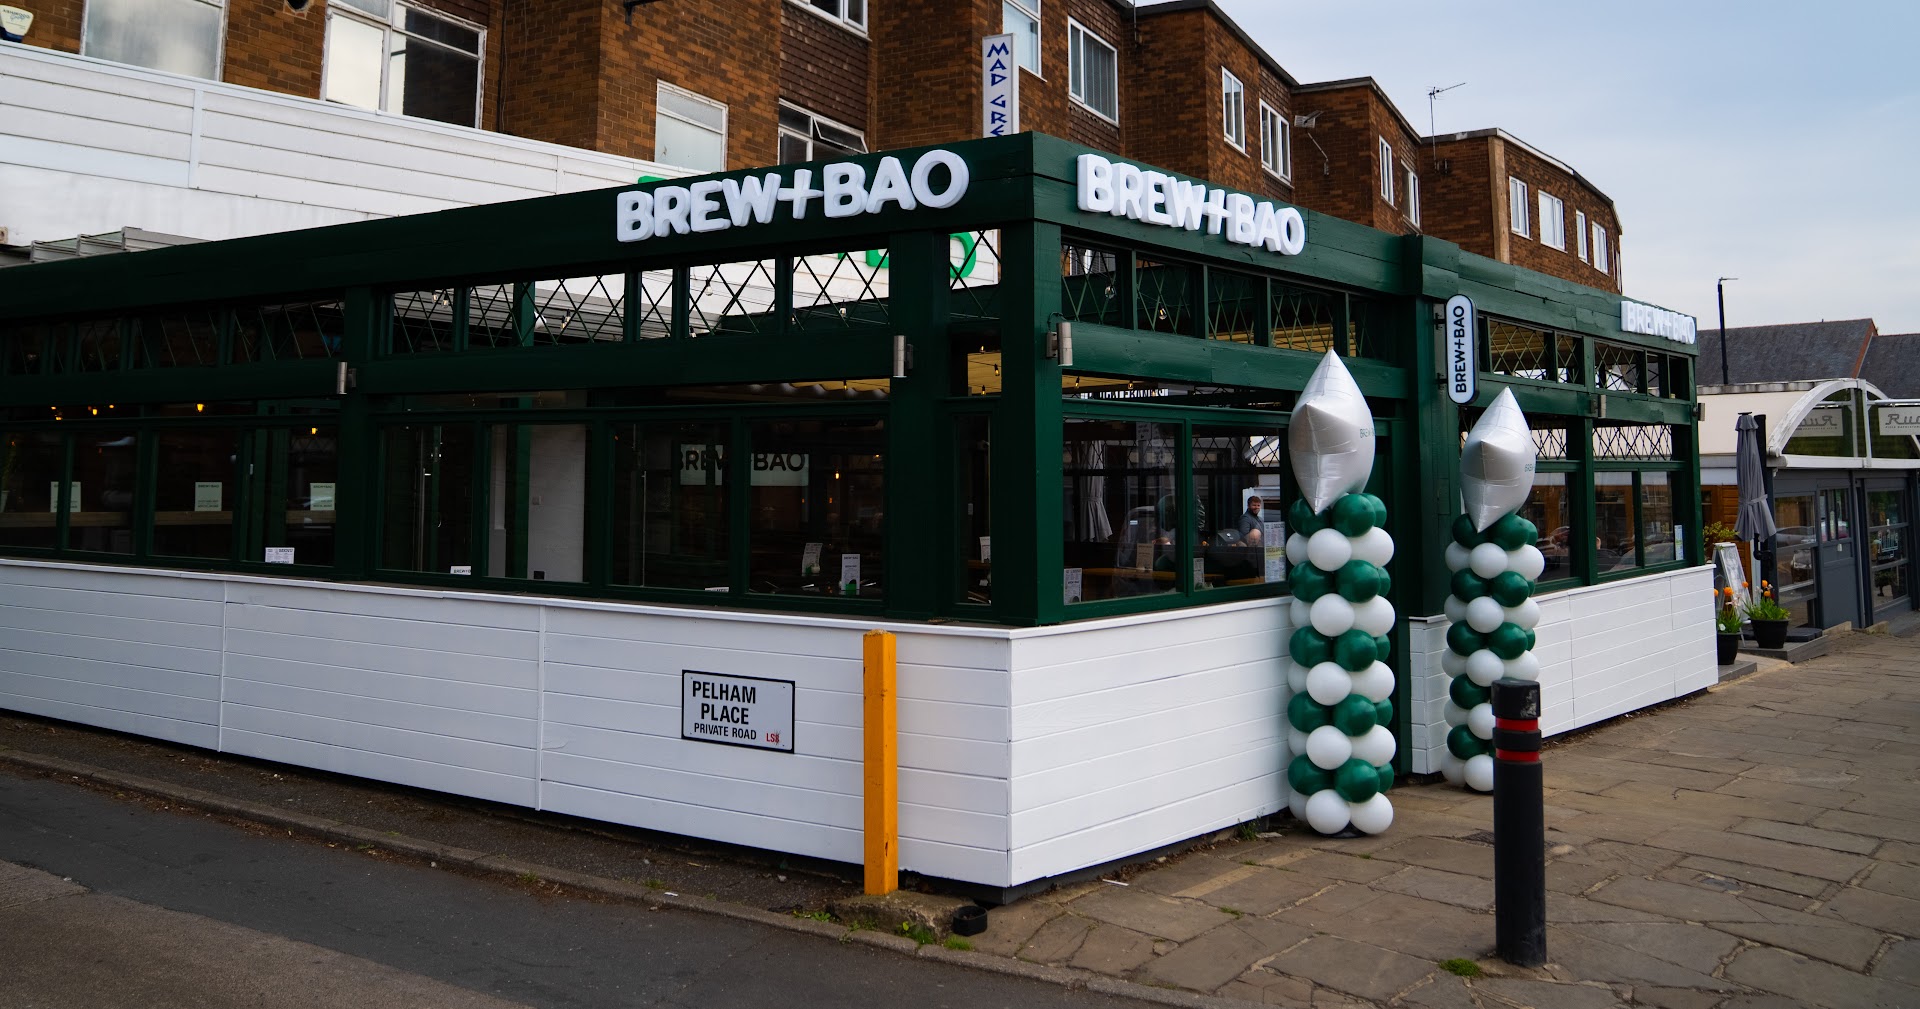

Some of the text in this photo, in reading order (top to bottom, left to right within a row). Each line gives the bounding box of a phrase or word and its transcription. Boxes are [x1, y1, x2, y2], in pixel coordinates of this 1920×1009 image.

[986, 42, 1009, 87] MAD
[616, 149, 970, 242] BREW+BAO
[1077, 153, 1305, 256] BREW+BAO
[1621, 300, 1695, 344] BREW+BAO
[1452, 305, 1467, 393] BREW+BAO
[692, 680, 756, 704] PELHAM
[701, 702, 749, 725] PLACE
[694, 722, 729, 737] PRIVATE
[731, 726, 757, 740] ROAD
